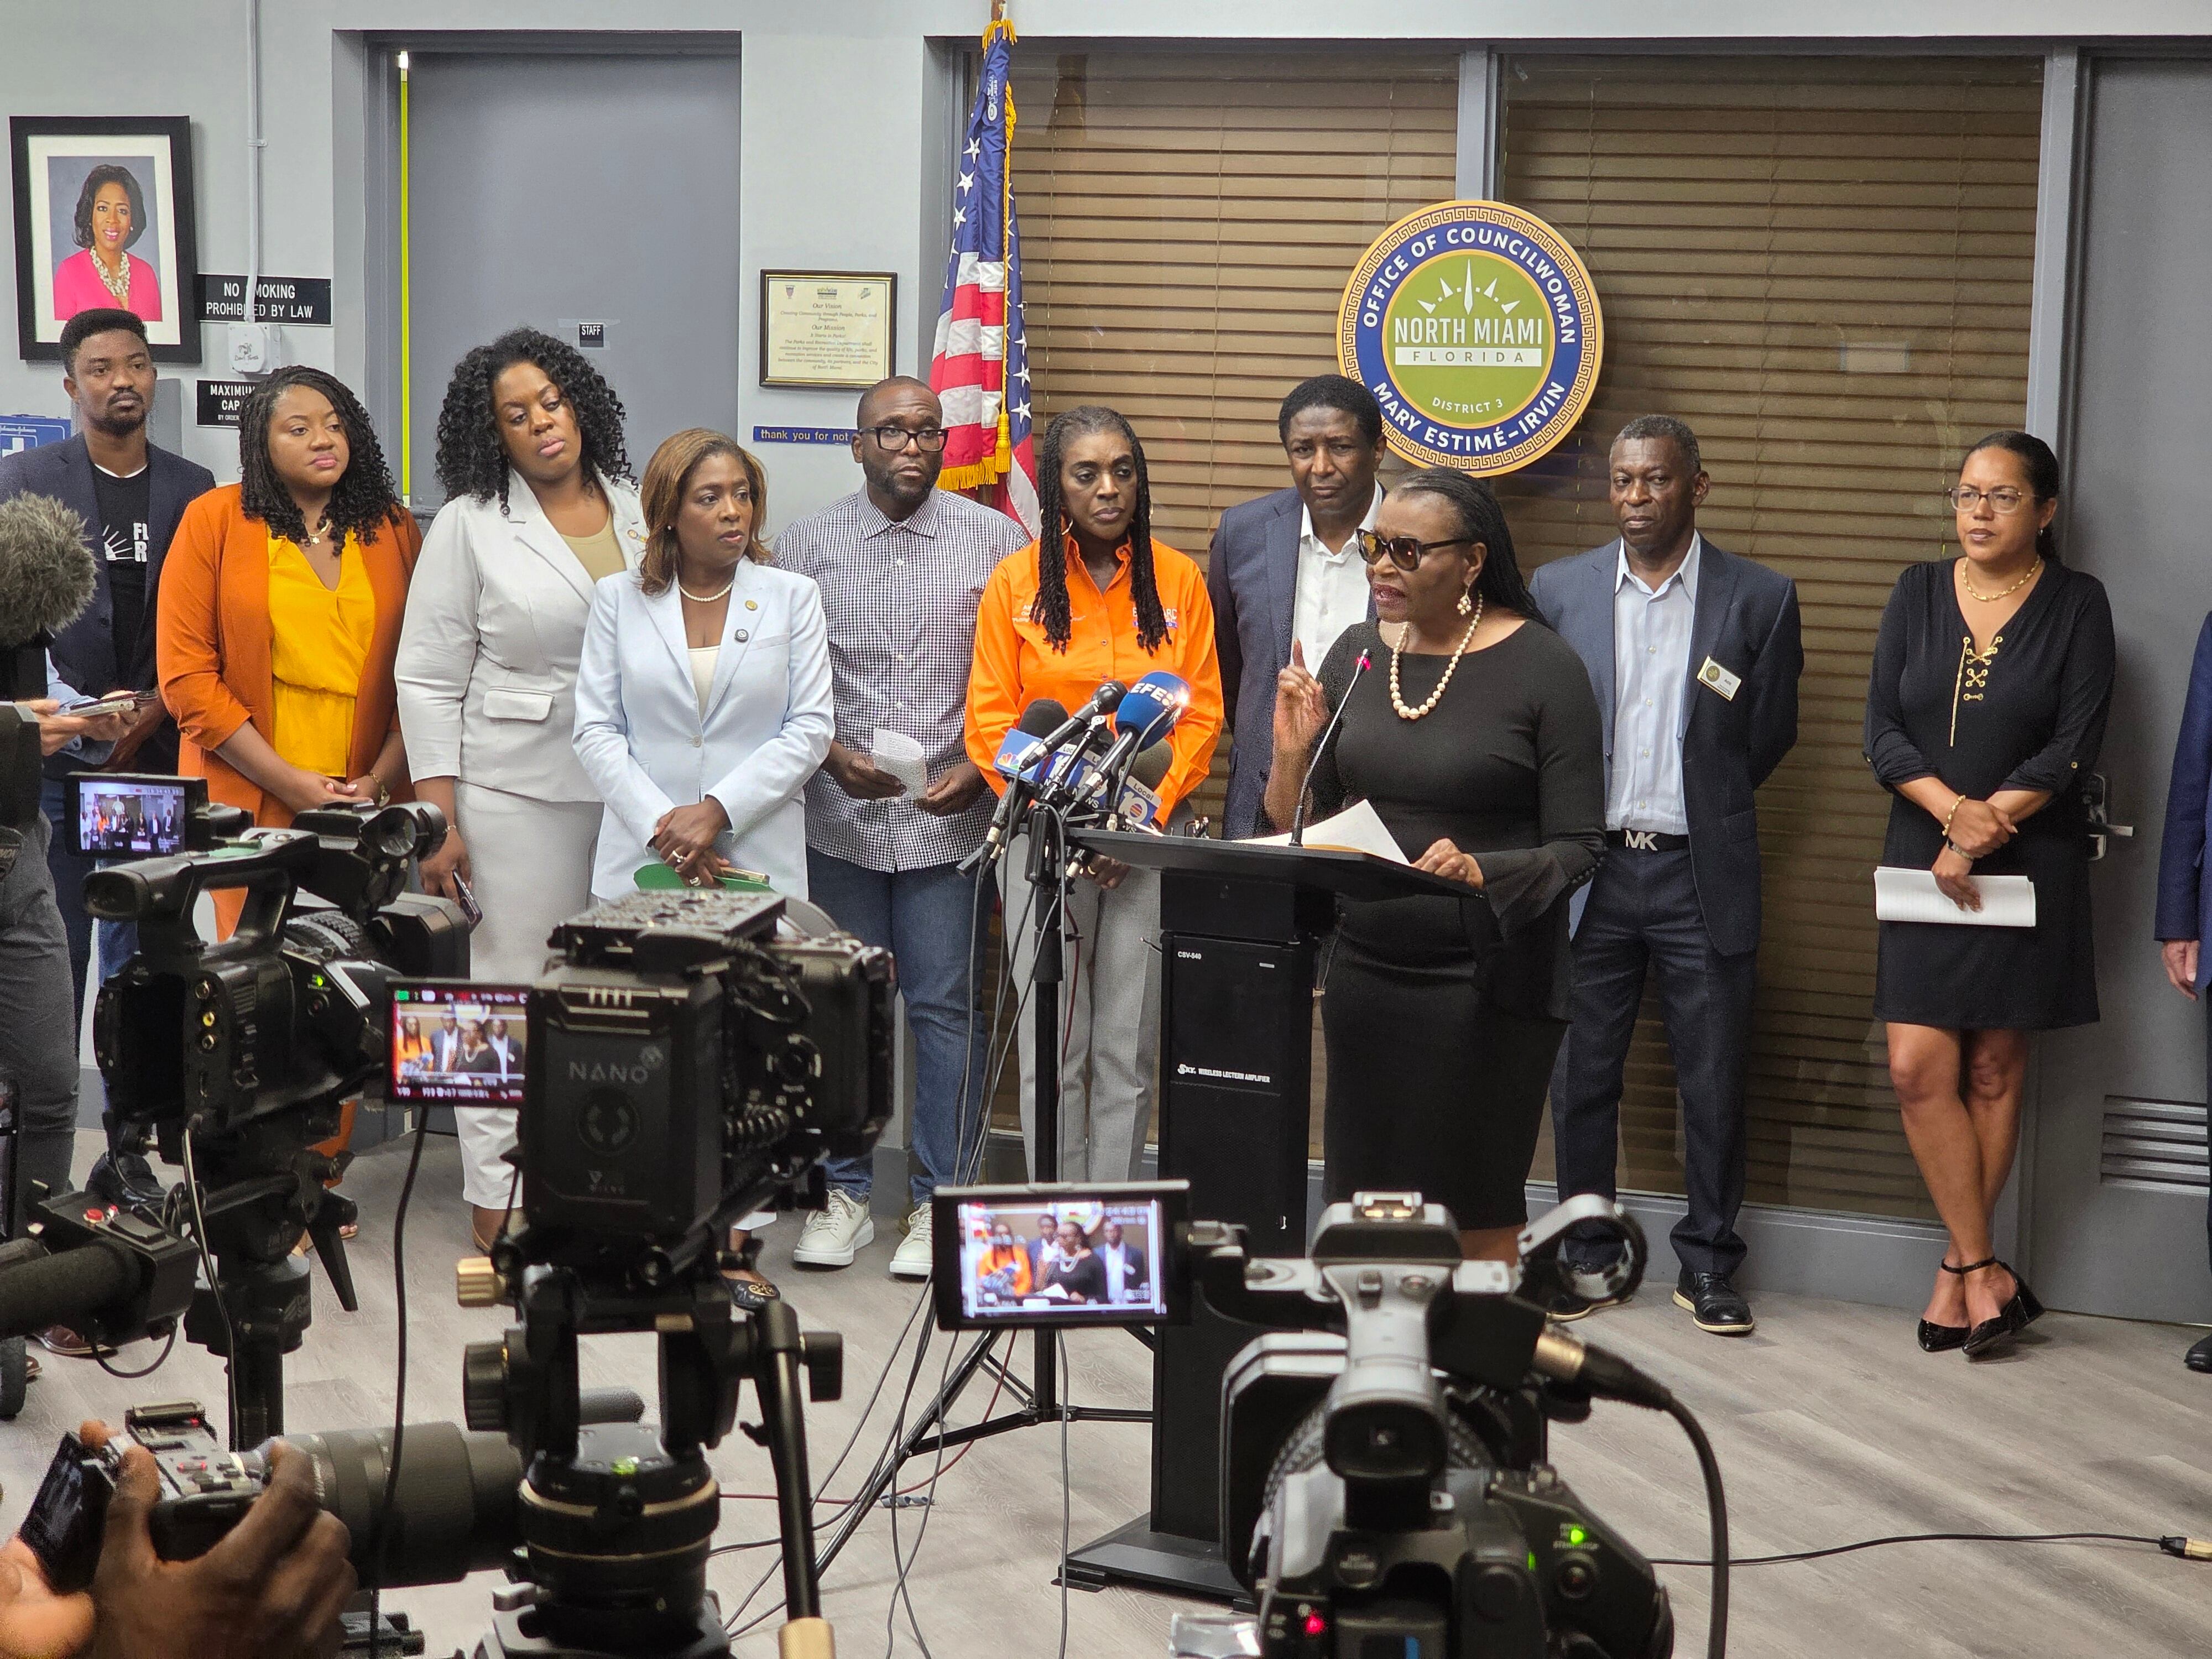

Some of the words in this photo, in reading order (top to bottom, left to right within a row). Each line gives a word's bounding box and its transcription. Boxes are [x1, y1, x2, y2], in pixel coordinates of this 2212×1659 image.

[224, 283, 239, 297] NO
[255, 284, 295, 299] MOKING
[1363, 254, 1409, 327] OFFICE
[1411, 234, 1437, 258] OF
[1446, 227, 1575, 343] COUNCILWOMAN
[271, 305, 285, 317] BY
[290, 305, 312, 319] LAW
[581, 325, 601, 336] STAFF
[1395, 317, 1465, 343] NORTH
[1474, 319, 1542, 345] MIAMI
[1413, 351, 1524, 362] FLORIDA
[1373, 382, 1422, 432] MARY
[1432, 397, 1490, 414] DISTRICT
[1495, 398, 1503, 408] 3
[761, 429, 787, 440] thank
[793, 432, 810, 441] you
[815, 431, 828, 441] for
[1133, 783, 1154, 801] Local
[1118, 791, 1148, 823] 10
[1625, 830, 1658, 851] MK
